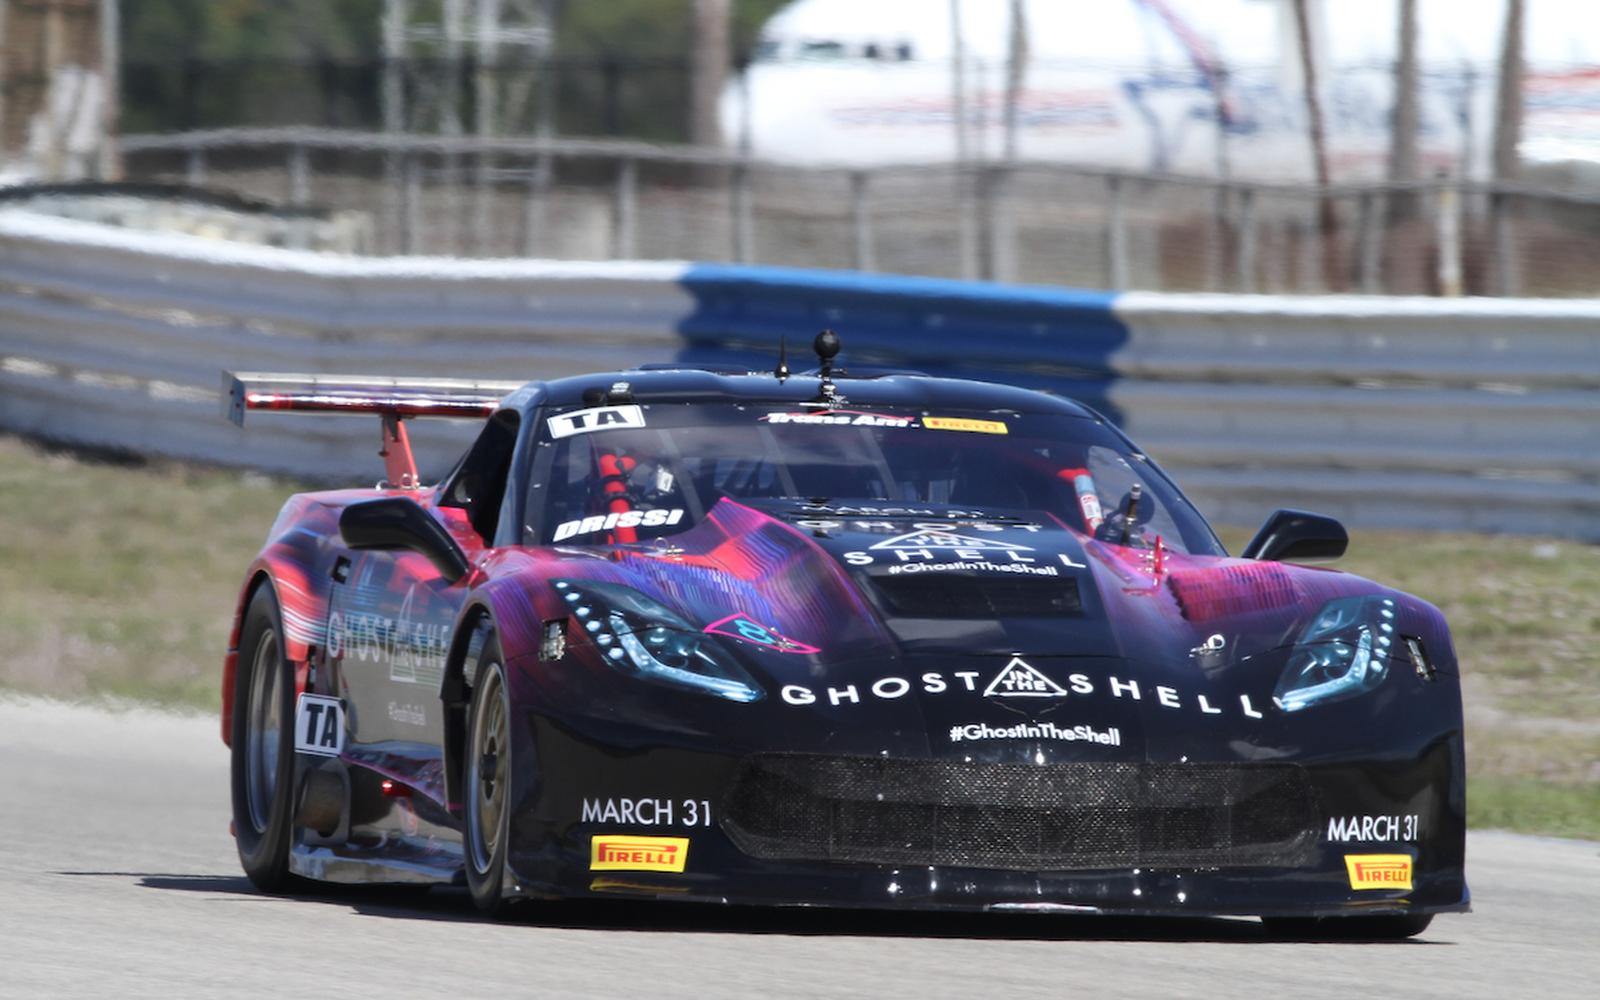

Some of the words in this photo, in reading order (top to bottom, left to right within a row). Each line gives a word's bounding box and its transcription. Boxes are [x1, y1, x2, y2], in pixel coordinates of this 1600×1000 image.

[562, 410, 628, 429] TA
[767, 410, 851, 424] Trans
[552, 508, 685, 542] DRISSI
[843, 549, 1087, 569] SHELL
[888, 561, 1059, 576] #GhostInTheShell
[327, 611, 392, 663] GHOST
[1001, 680, 1047, 691] THE
[1009, 670, 1034, 681] IN
[781, 672, 980, 706] GHOST
[1068, 673, 1263, 719] SHELL
[305, 703, 338, 748] TA
[949, 722, 1121, 746] #GhostInTheShell
[581, 798, 674, 825] MARCH
[682, 799, 711, 827] 31
[1327, 815, 1400, 842] MARCH
[1403, 815, 1419, 841] 31
[598, 842, 678, 865] PIRELLI
[1355, 862, 1409, 882] PIRELLI
